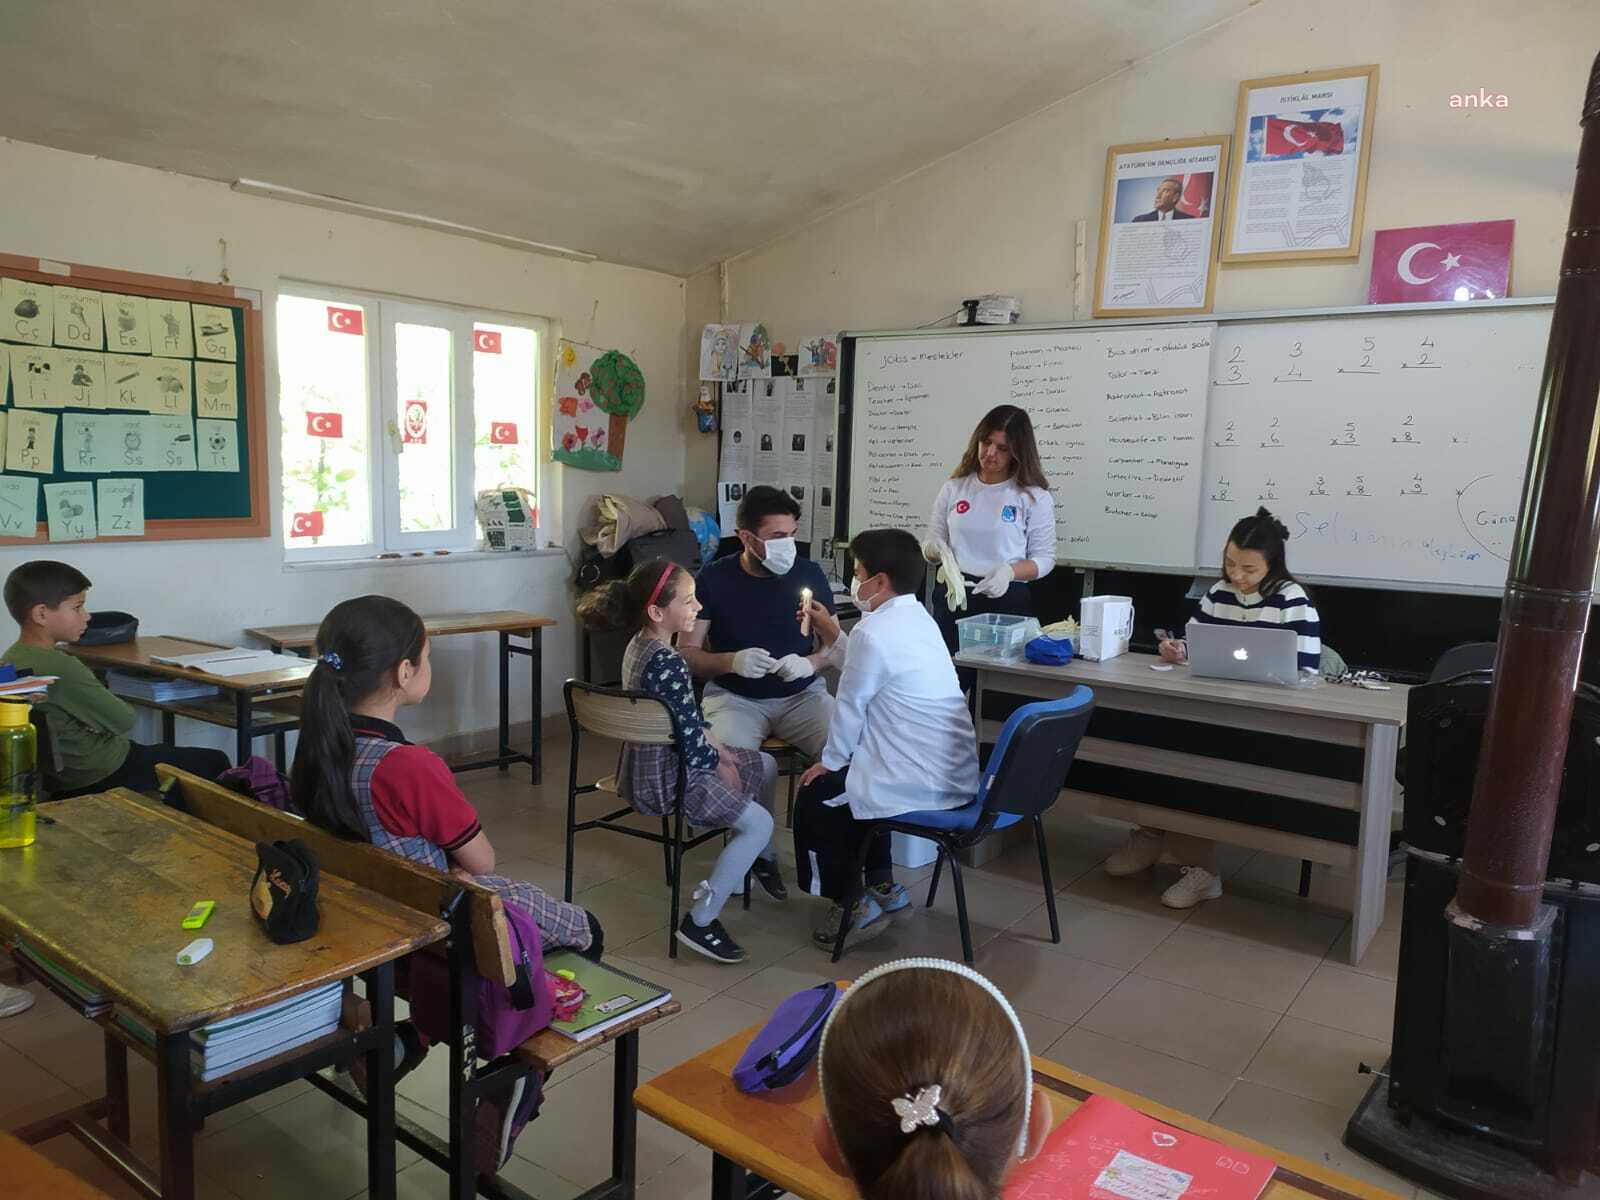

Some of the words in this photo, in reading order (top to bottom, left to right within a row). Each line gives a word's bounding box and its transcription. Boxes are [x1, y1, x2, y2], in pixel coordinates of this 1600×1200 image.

[67, 324, 91, 341] Dd
[119, 333, 137, 347] Ee
[1362, 337, 1376, 351] 5
[1421, 336, 1434, 348] 4
[1227, 345, 1246, 363] 2
[1288, 342, 1303, 357] 3
[1359, 356, 1373, 368] 2
[1418, 354, 1433, 364] 2
[1227, 365, 1242, 381] 3
[1287, 363, 1303, 377] 4
[119, 390, 137, 405] Kk
[203, 397, 232, 411] Mm
[1225, 421, 1236, 430] 2
[1270, 416, 1281, 428] 2
[1401, 415, 1415, 425] 2
[1344, 422, 1356, 432] 5
[1225, 433, 1235, 442] 2
[1270, 432, 1279, 444] 6
[1344, 433, 1356, 444] 3
[1404, 432, 1413, 441] 8
[21, 449, 41, 470] Pp
[79, 450, 97, 466] Rr
[1316, 476, 1326, 486] 3
[1219, 489, 1227, 500] 8
[62, 519, 85, 538] Yy
[111, 514, 132, 530] Zz
